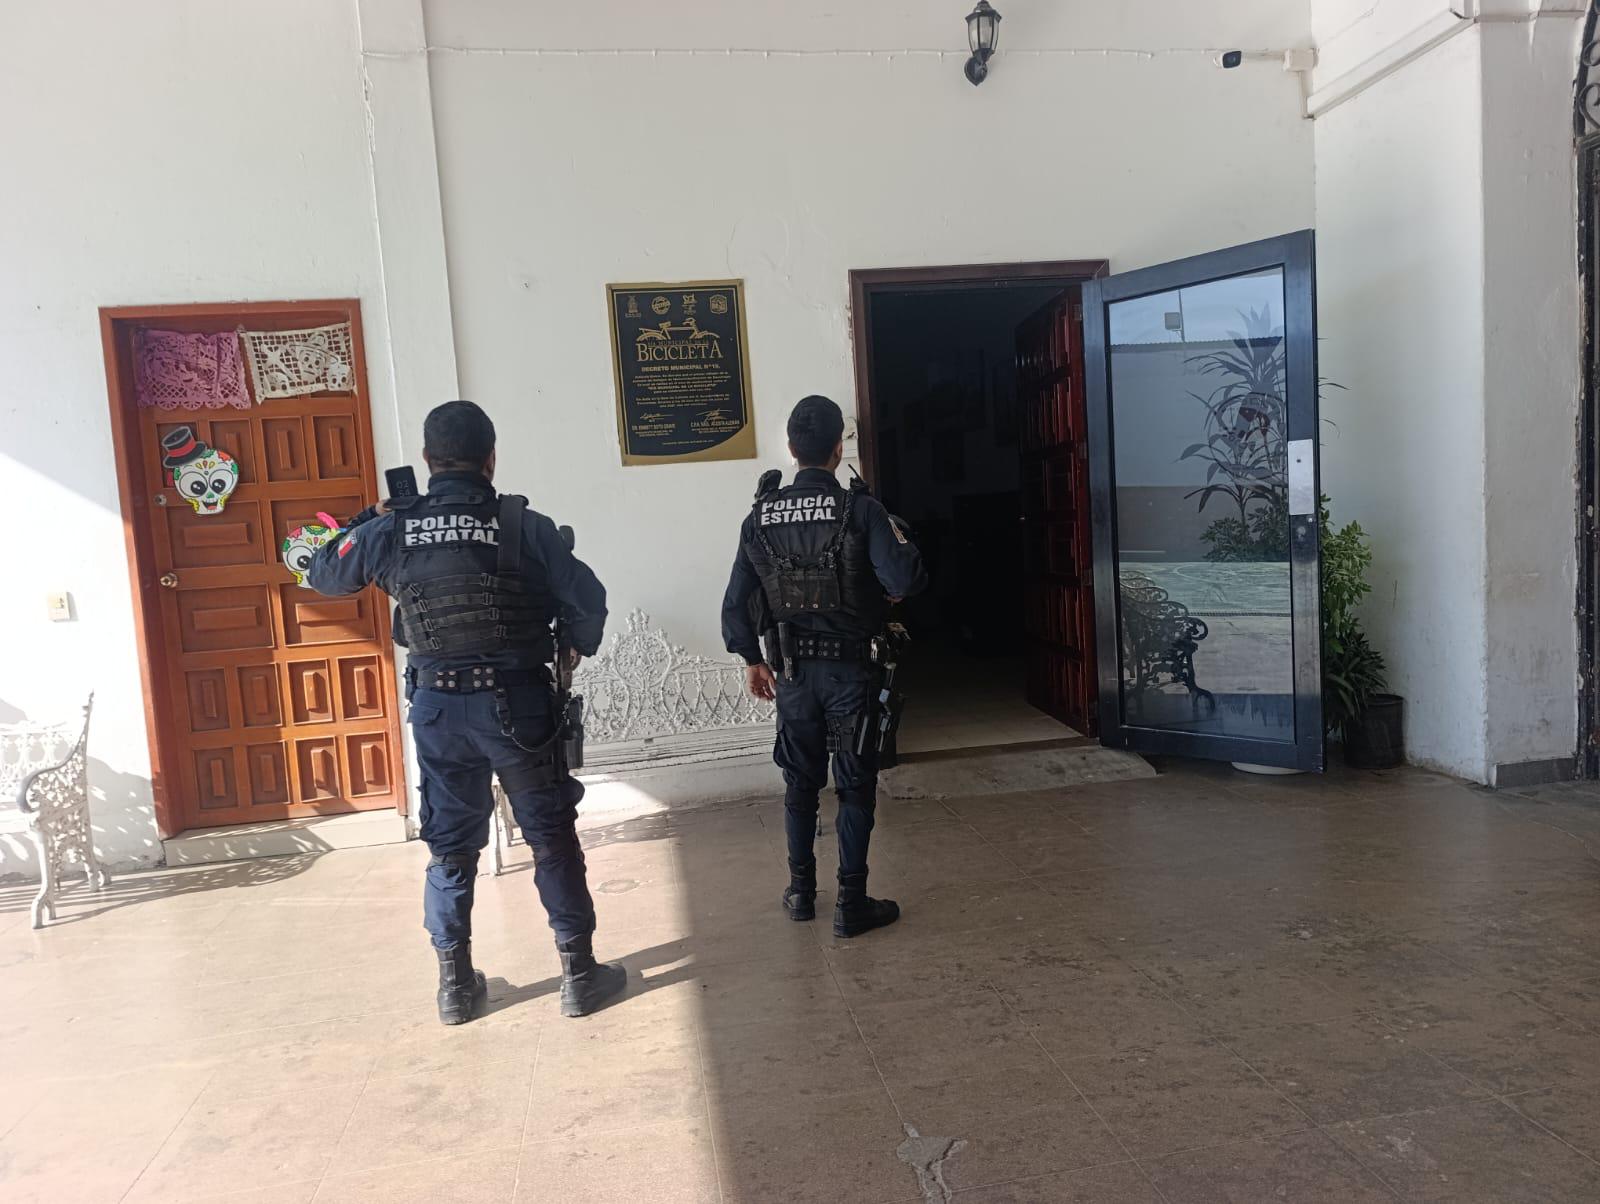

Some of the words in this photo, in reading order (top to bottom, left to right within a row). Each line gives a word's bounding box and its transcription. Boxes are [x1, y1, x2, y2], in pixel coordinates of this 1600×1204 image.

[635, 340, 724, 362] BICICLETA
[761, 508, 836, 526] ESTATAL
[405, 529, 499, 547] ESTATAL
